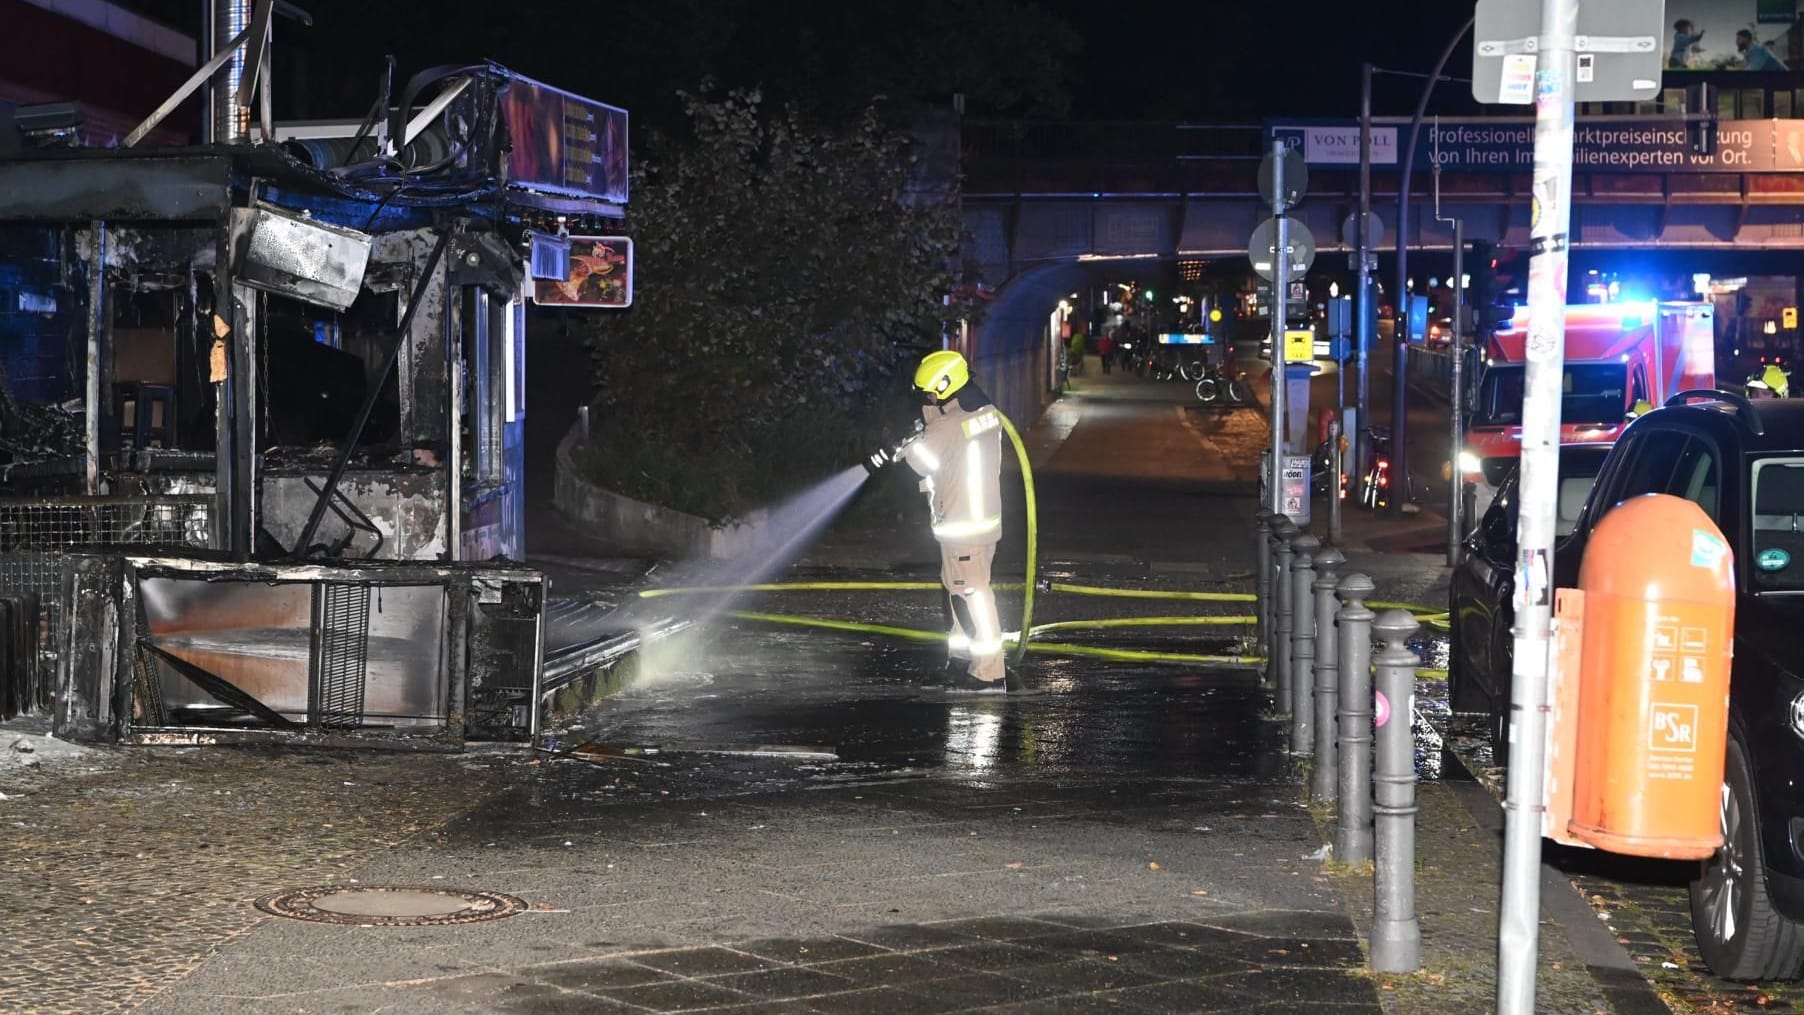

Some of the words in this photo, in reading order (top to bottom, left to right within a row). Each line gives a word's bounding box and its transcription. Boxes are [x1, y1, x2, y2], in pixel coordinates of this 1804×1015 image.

[1314, 135, 1346, 146] VON
[1353, 135, 1391, 146] PLL
[1429, 127, 1536, 144] Professionell
[1429, 151, 1459, 164] von
[1466, 148, 1509, 164] Ihren
[1516, 148, 1683, 167] Imilienexperten
[1722, 149, 1752, 165] Ort.
[1655, 712, 1691, 743] BSR
